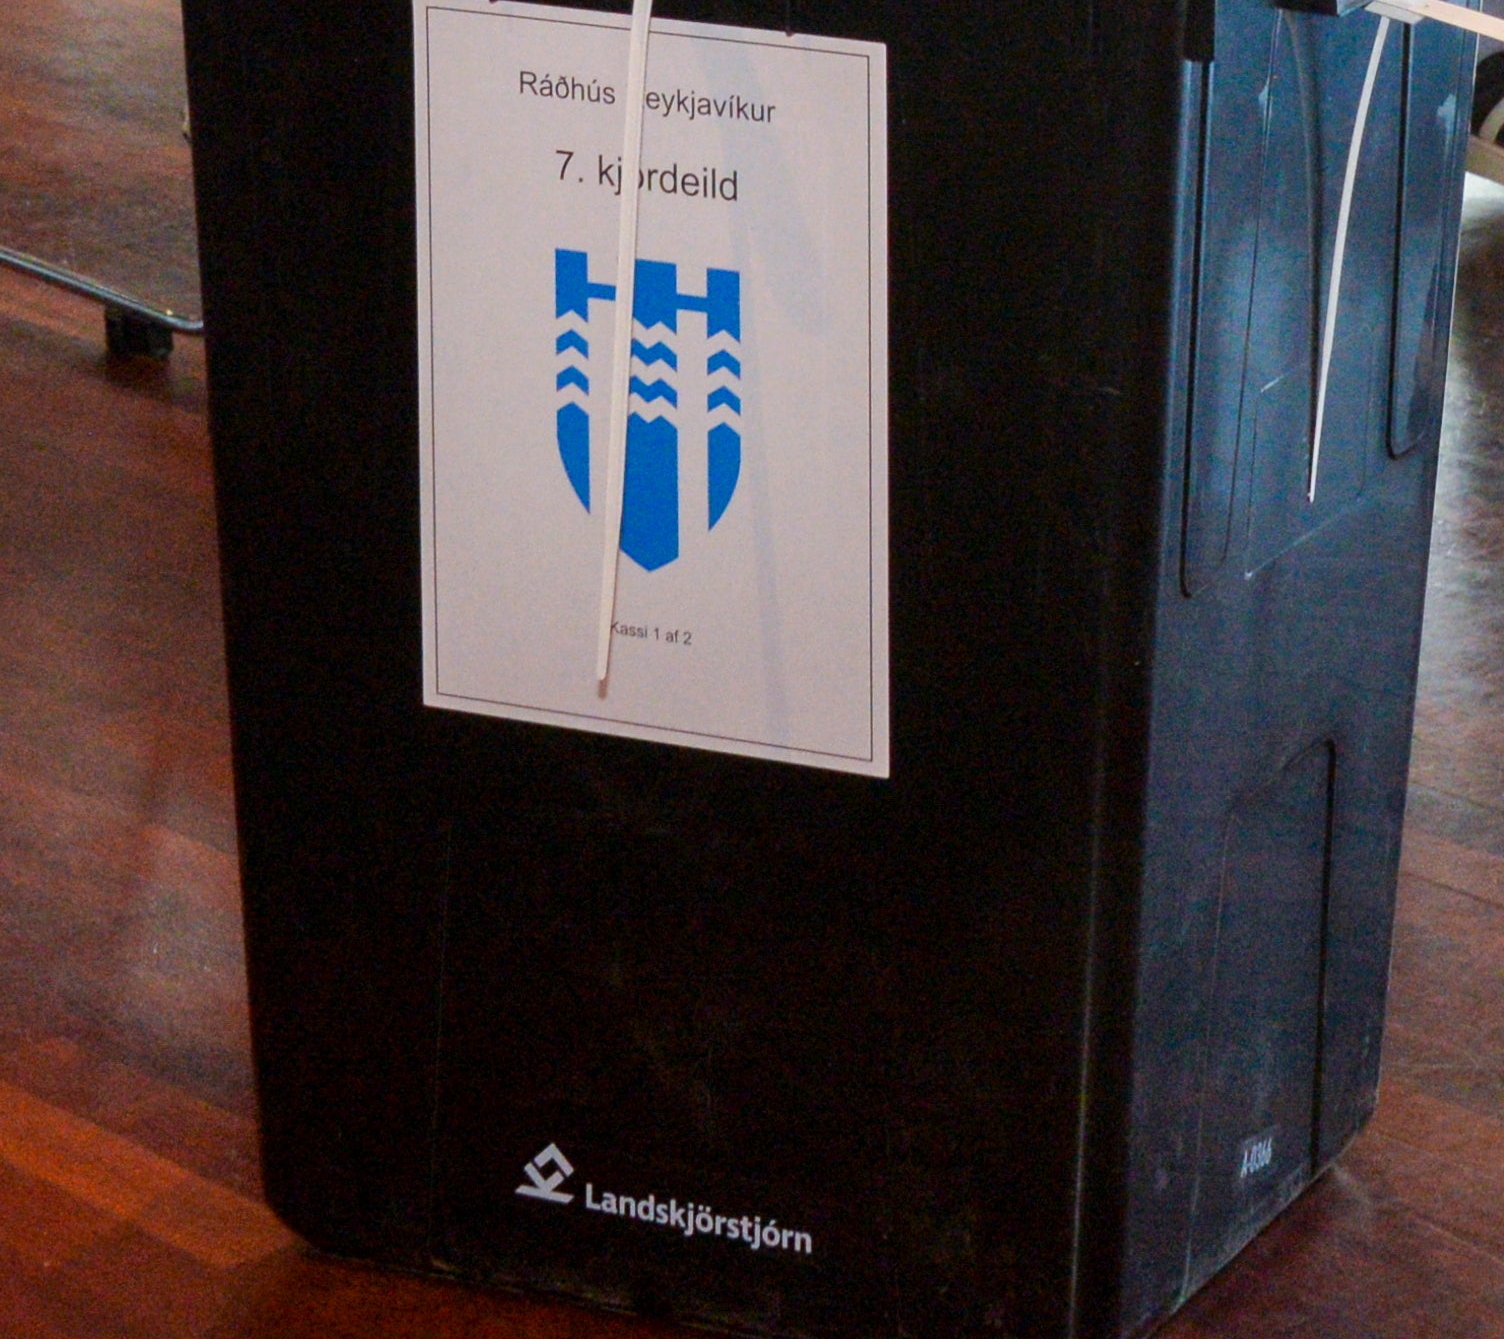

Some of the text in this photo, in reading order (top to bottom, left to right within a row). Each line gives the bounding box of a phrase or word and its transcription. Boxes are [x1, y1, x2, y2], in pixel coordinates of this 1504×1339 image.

[518, 70, 777, 124] Ráðhús eykjavíkur
[554, 149, 585, 184] 7.
[654, 627, 660, 641] 1
[665, 629, 679, 644] af
[683, 631, 693, 646] 2
[584, 1182, 813, 1255] Landskjörstjórn
